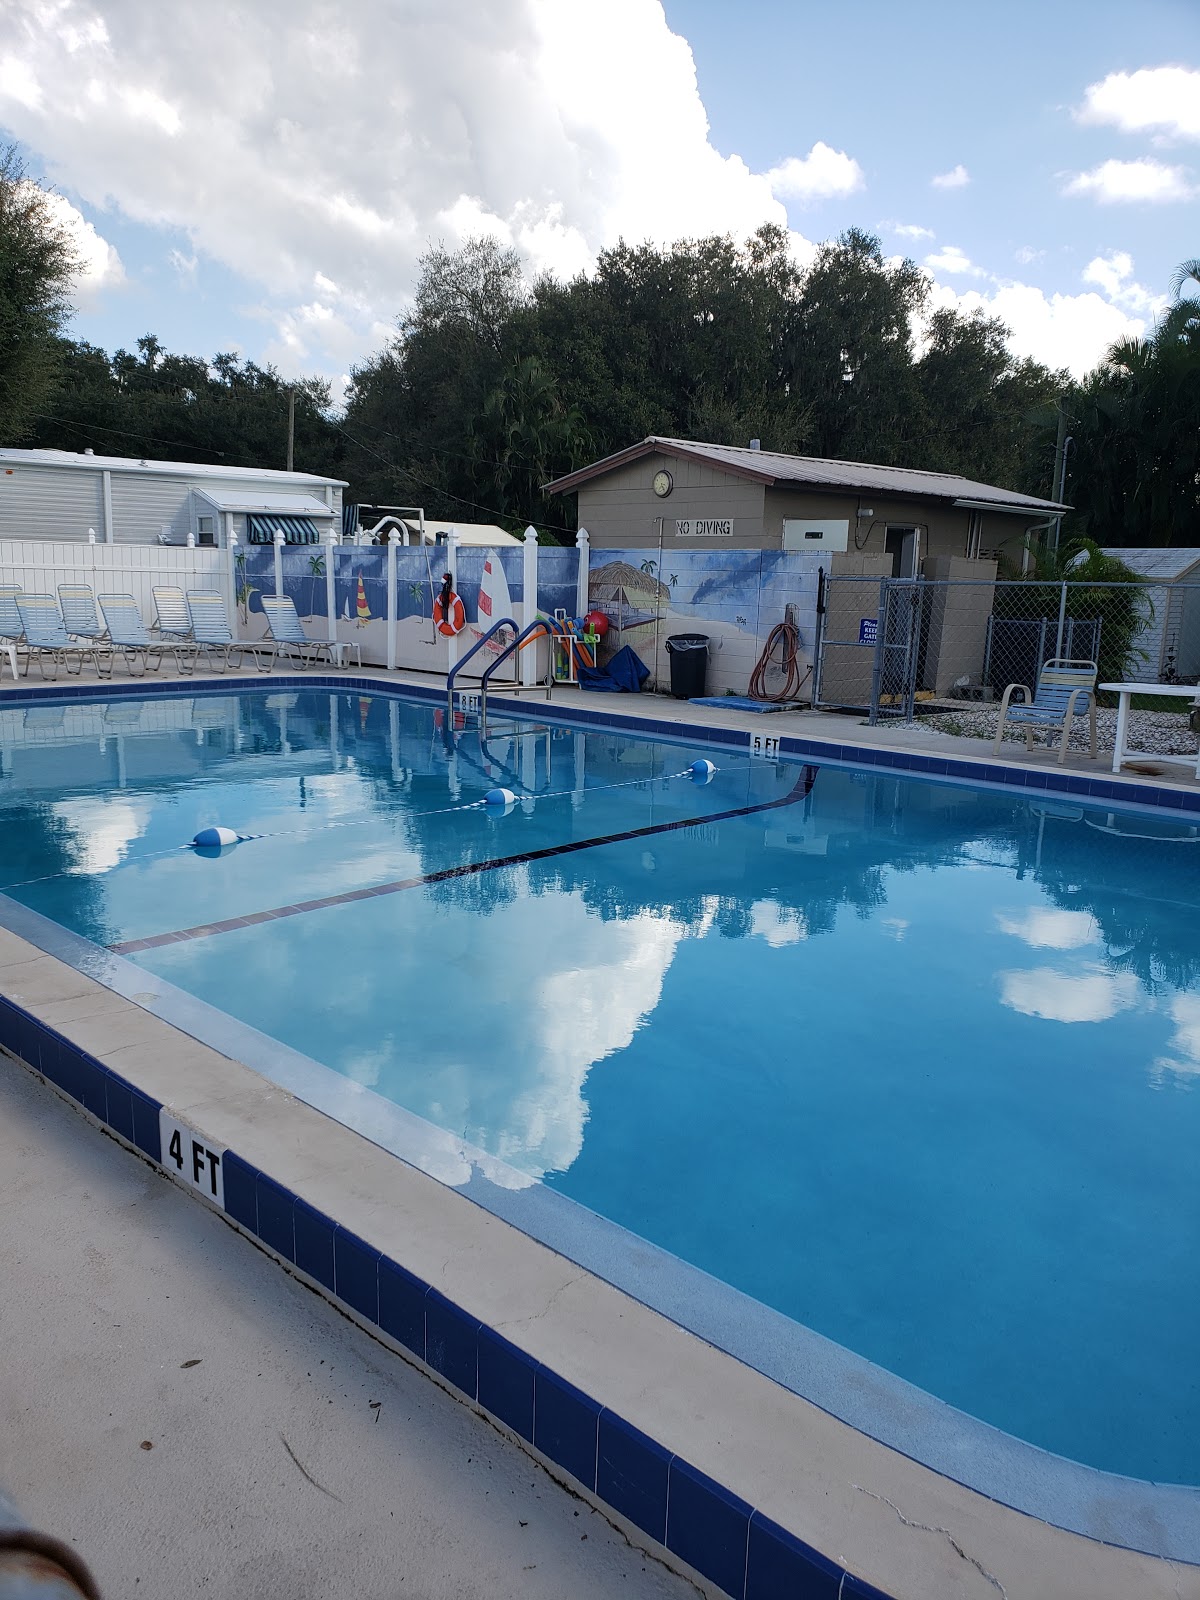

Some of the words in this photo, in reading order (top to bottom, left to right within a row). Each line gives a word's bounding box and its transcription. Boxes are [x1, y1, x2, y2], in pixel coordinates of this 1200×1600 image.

[677, 521, 690, 535] NO
[696, 520, 731, 535] DIVING
[754, 737, 761, 748] 5
[765, 737, 779, 751] FT
[169, 1129, 183, 1171] 4
[192, 1139, 220, 1197] FT
